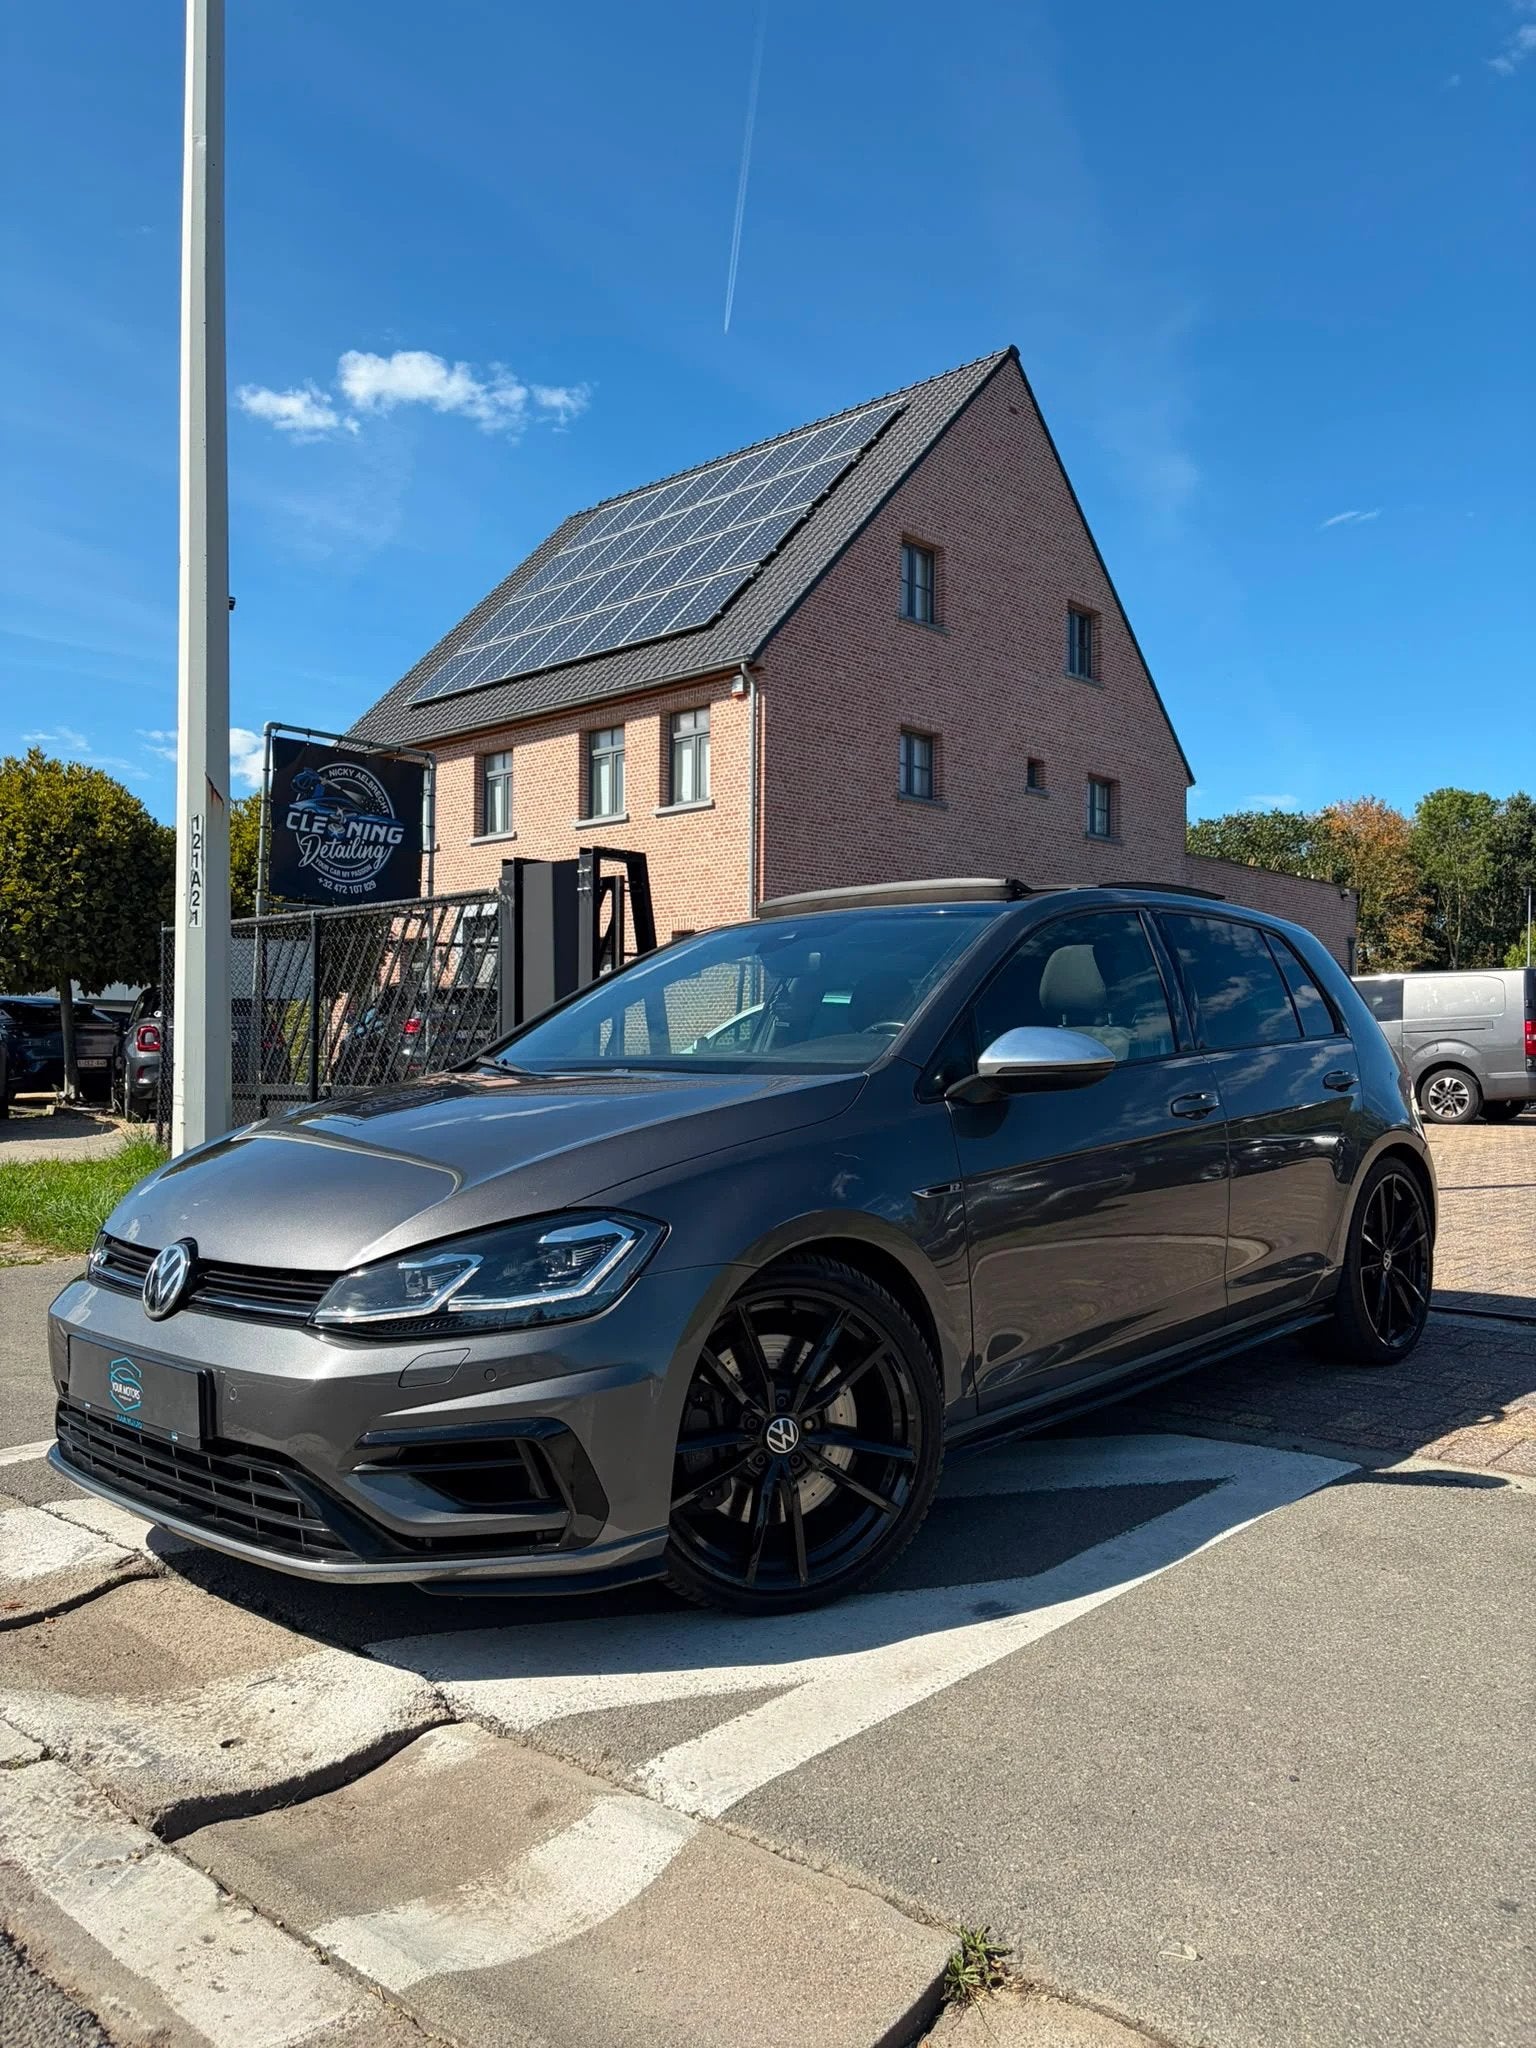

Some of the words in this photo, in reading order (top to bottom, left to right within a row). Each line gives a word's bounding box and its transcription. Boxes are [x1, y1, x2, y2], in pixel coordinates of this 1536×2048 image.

[328, 767, 354, 777] NICKY
[355, 772, 390, 814] AELBRECHT
[286, 811, 405, 844] CLENING
[298, 834, 389, 869] Detailing
[315, 857, 330, 872] YOUR
[330, 867, 341, 877] CAR
[341, 870, 350, 878] MY
[351, 863, 373, 878] PASSION
[191, 814, 201, 925] 121A21
[317, 877, 333, 890] +32
[334, 884, 348, 894] 472
[349, 885, 363, 894] 107
